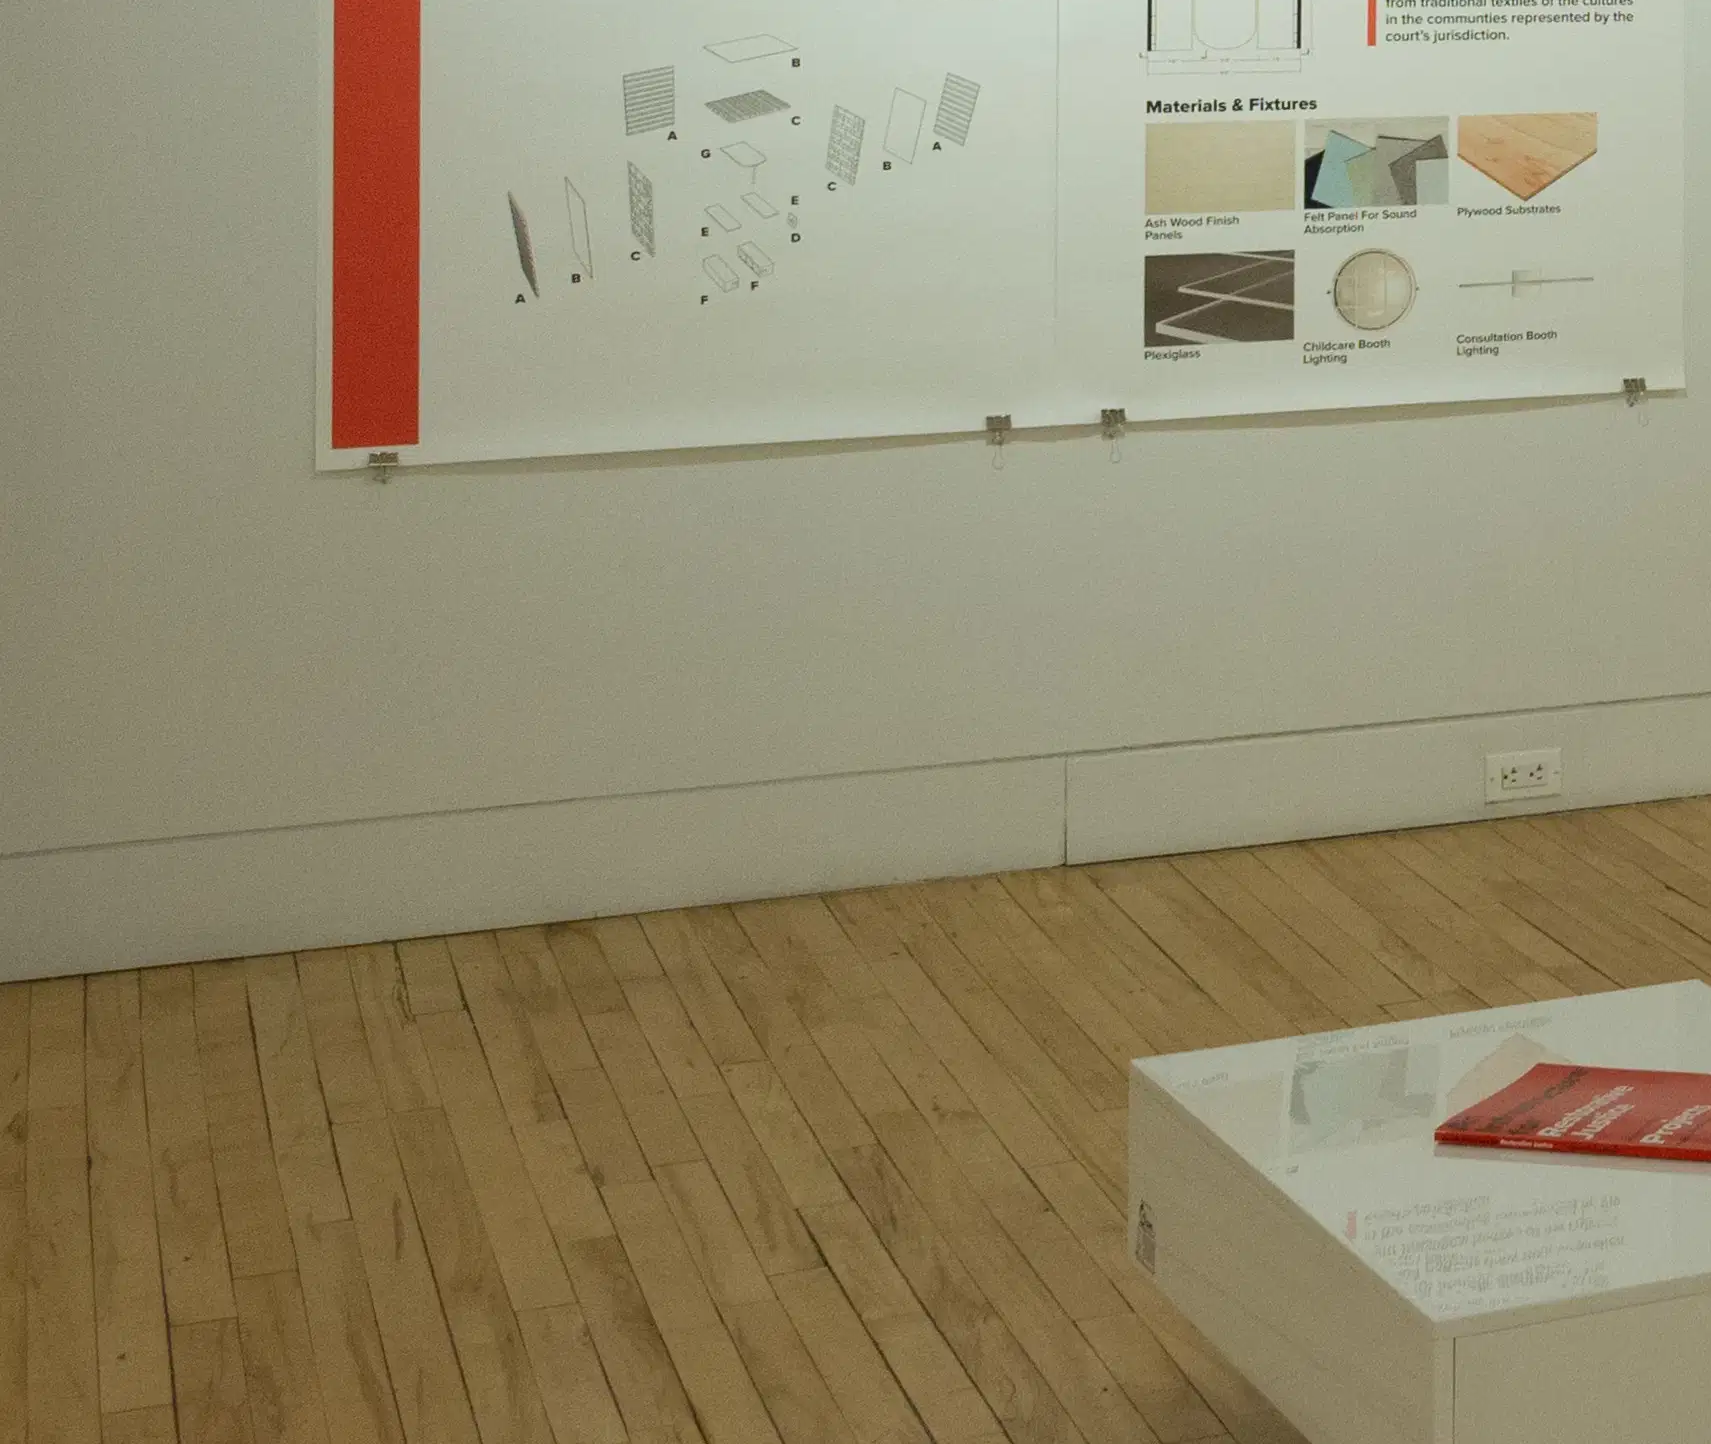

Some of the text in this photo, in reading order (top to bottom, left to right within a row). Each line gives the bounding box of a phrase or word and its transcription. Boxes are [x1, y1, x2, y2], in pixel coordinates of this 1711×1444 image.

[1146, 97, 1317, 114] Materials & Fixtures
[1539, 1084, 1635, 1138] Restorative
[1571, 1103, 1635, 1141] Justice
